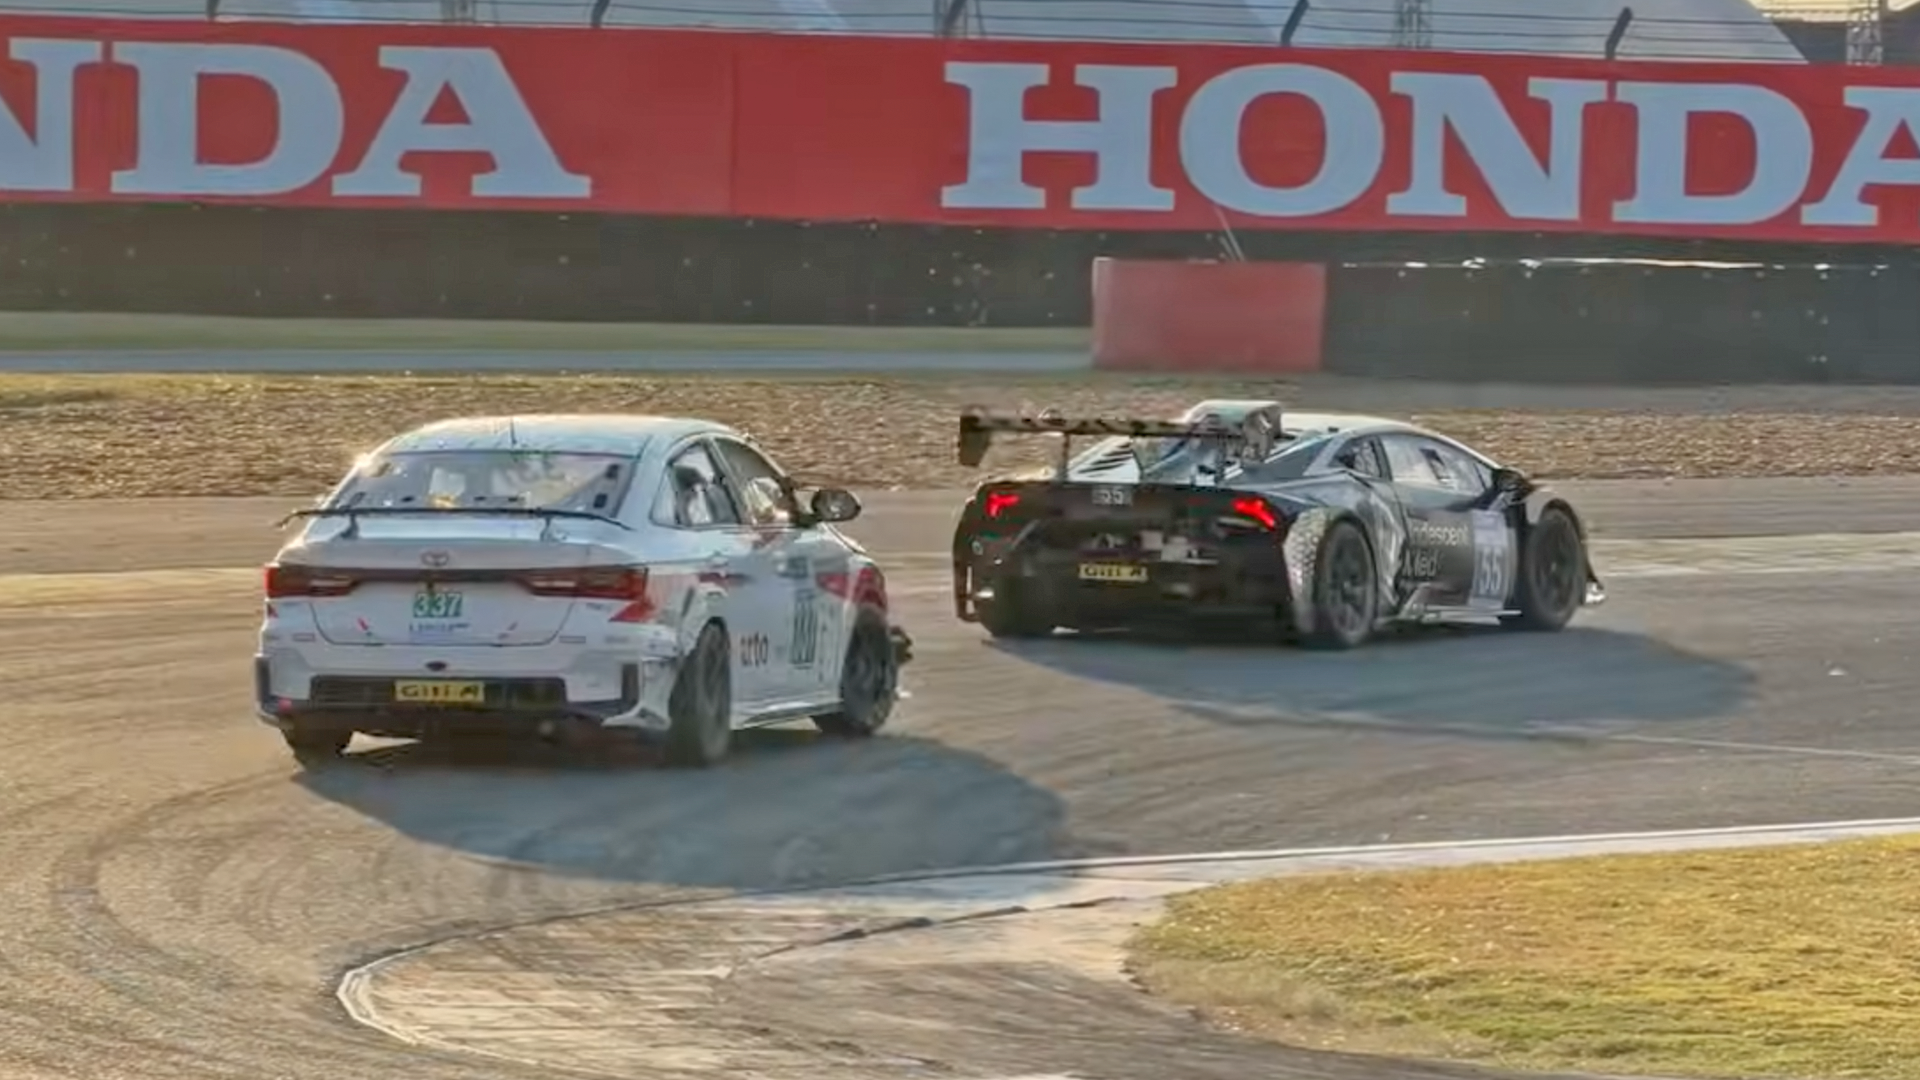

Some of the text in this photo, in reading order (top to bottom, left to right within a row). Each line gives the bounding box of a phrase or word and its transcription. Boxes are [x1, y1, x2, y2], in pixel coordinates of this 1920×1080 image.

[941, 61, 1920, 227] HONDA
[1479, 544, 1502, 596] 55
[413, 592, 462, 617] 337
[401, 684, 449, 697] Giti
